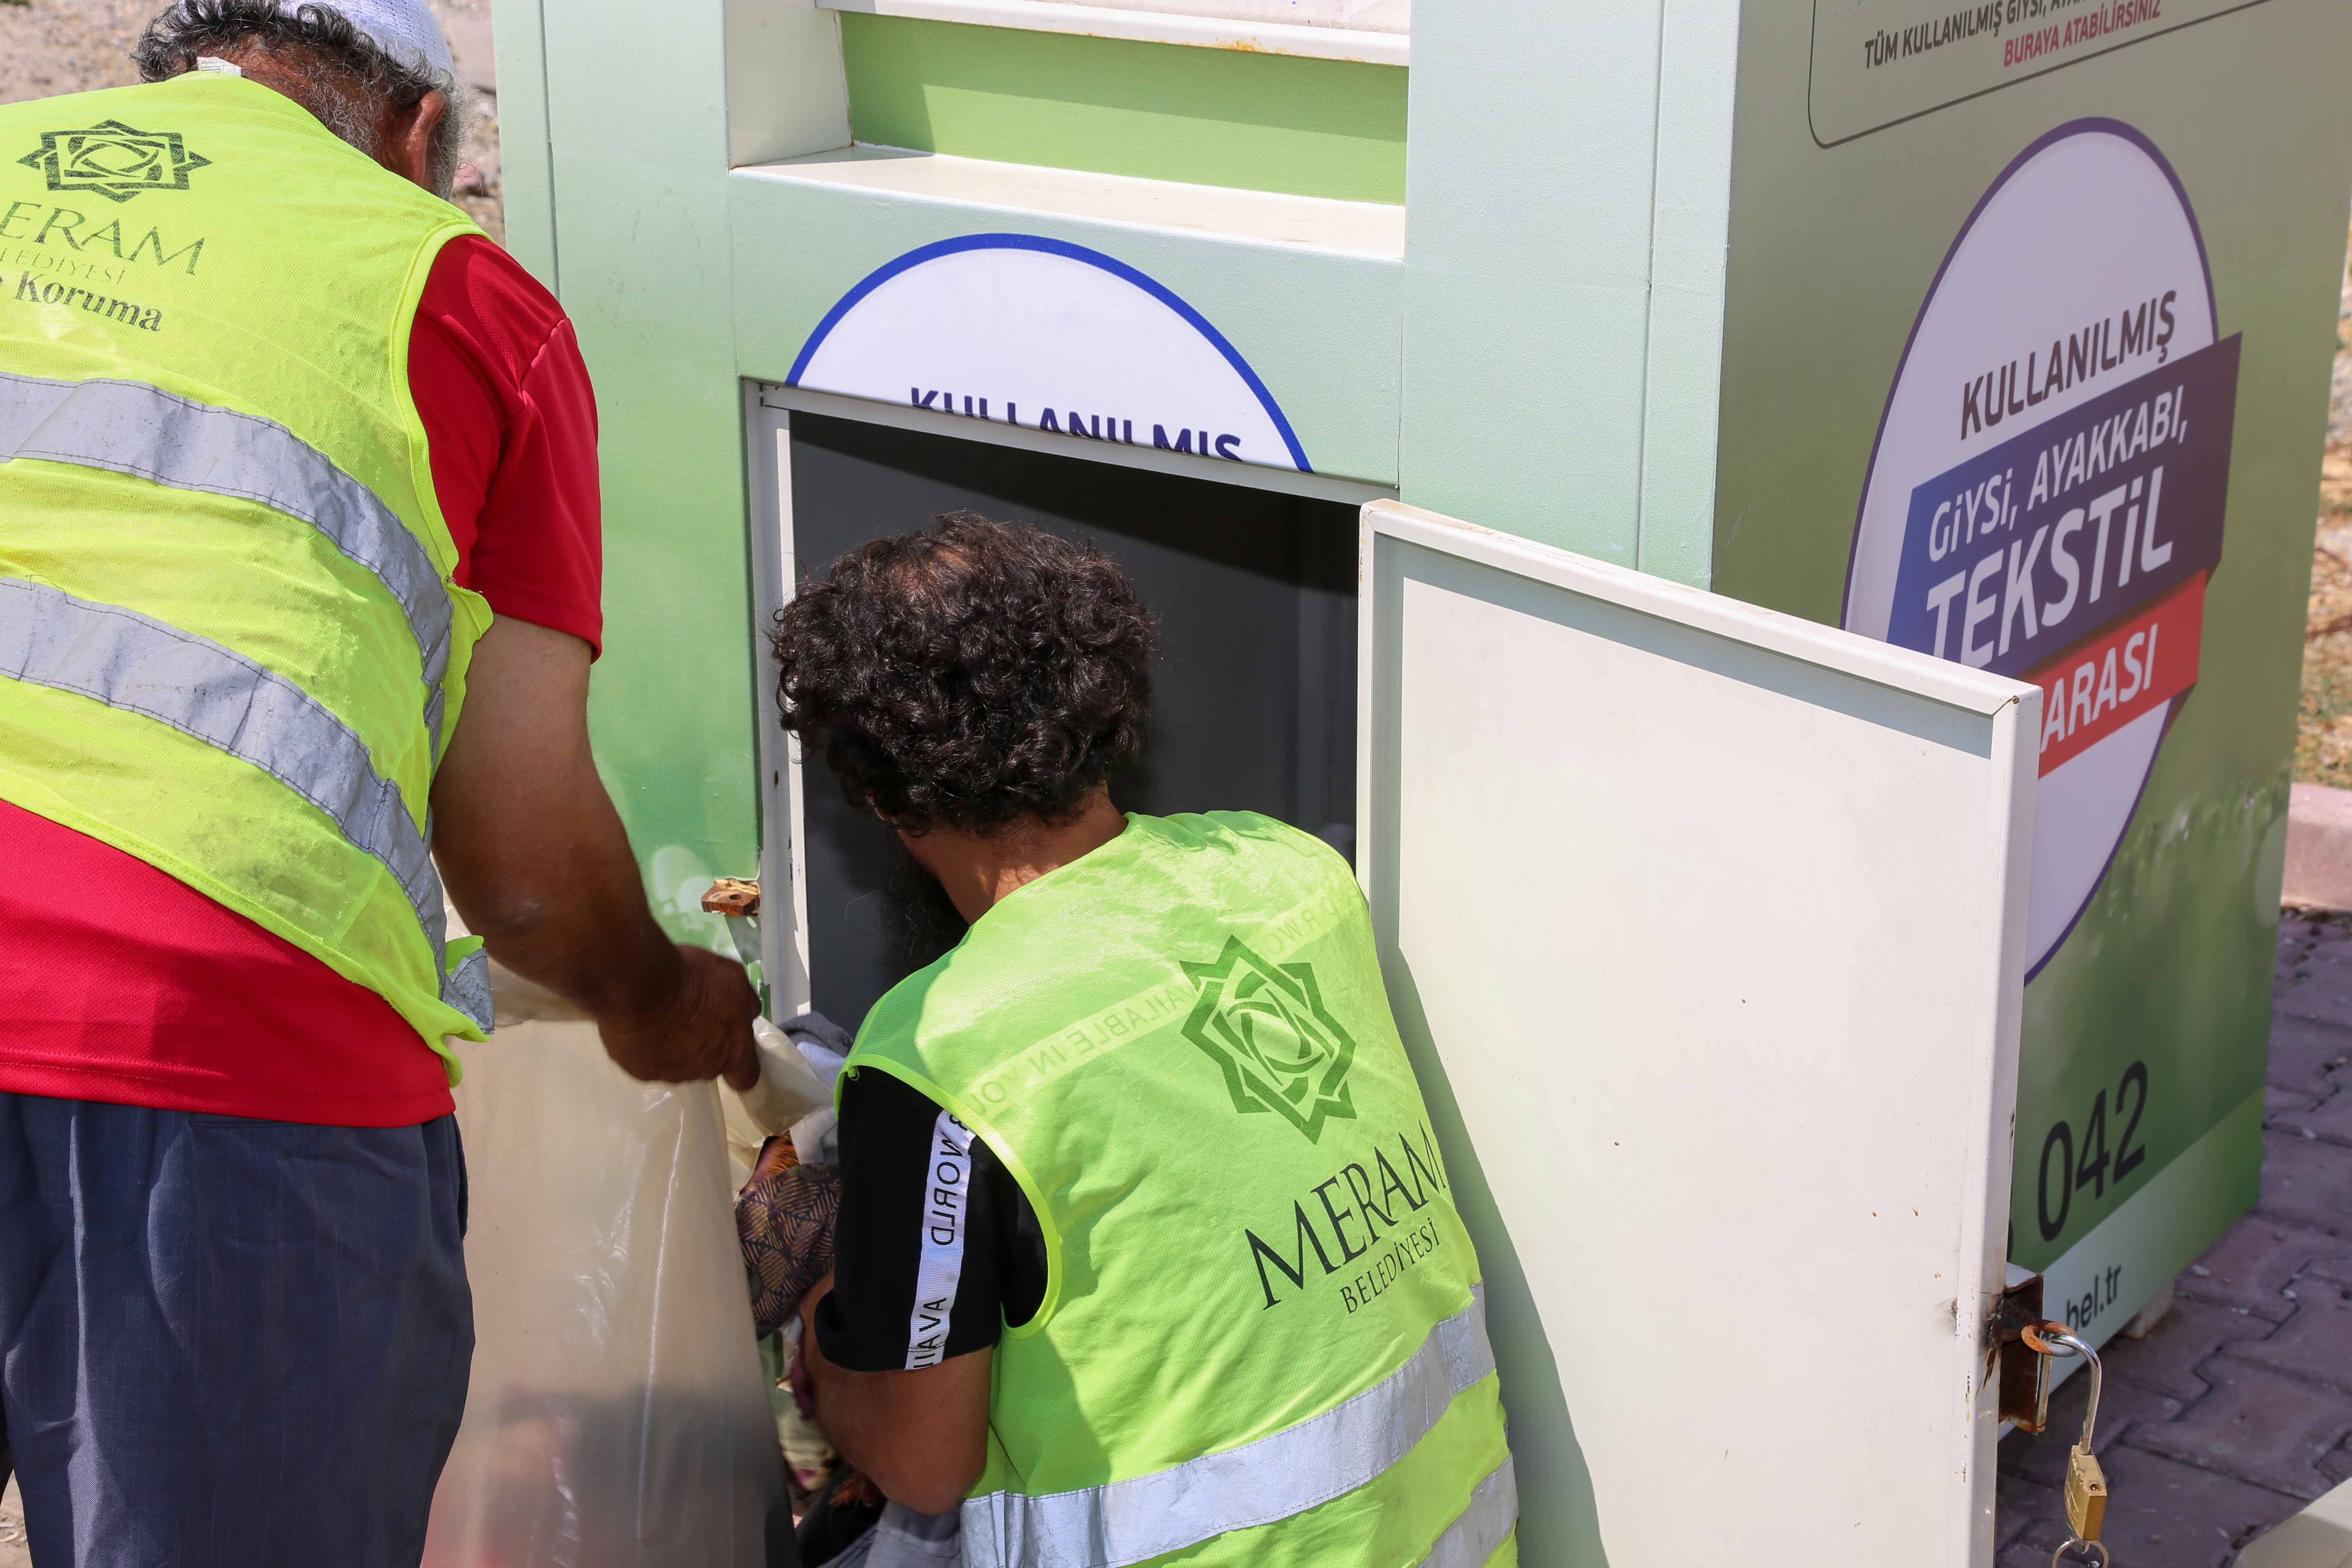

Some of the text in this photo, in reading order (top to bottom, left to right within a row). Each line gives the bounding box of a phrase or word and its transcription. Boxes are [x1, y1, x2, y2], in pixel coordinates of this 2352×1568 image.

[1864, 29, 1898, 69] TÜM
[1902, 0, 2002, 38] KULLANILMIŞ
[2004, 25, 2059, 67] BURAYA
[0, 201, 205, 276] ERAM
[15, 271, 162, 332] Koruma
[1961, 290, 2177, 441] KULLANILMIŞ
[2027, 385, 2188, 511] AYAKKABI,
[2038, 1060, 2148, 1243] 042
[1245, 1118, 1446, 1310] MERAM
[1339, 1217, 1441, 1314] BELEDİYESİ
